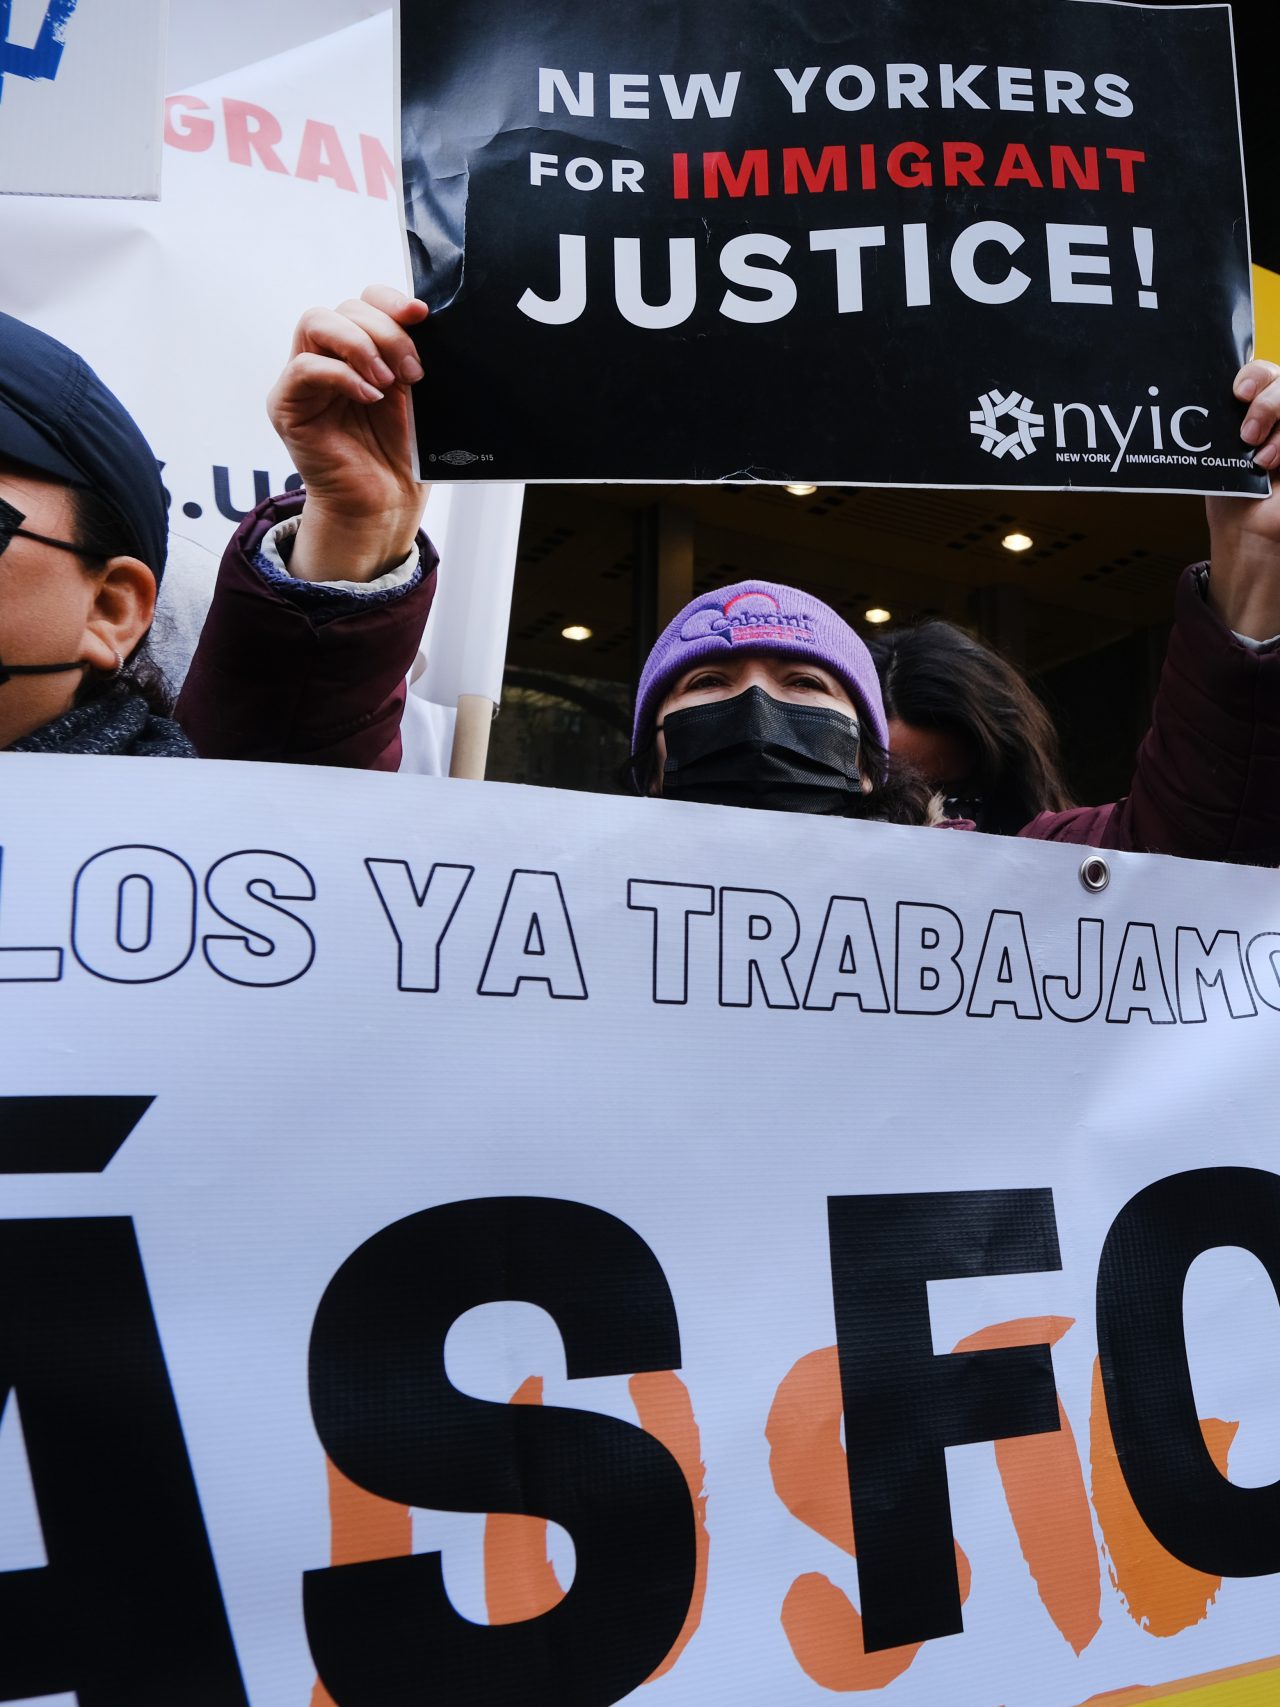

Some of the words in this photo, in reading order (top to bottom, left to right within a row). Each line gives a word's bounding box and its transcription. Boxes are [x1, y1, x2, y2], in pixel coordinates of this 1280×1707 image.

[538, 67, 741, 119] NEW
[774, 63, 1135, 118] YORKERS
[529, 153, 645, 193] FOR
[672, 140, 1146, 199] IMMIGRANT
[516, 221, 1160, 330] JUSTICE!
[1053, 385, 1213, 473] nyic
[1055, 452, 1081, 463] NEW
[1082, 453, 1112, 463] YORK
[1125, 454, 1198, 465] IMMIGRATION
[1200, 456, 1255, 469] COALITION
[363, 857, 589, 1000] YA
